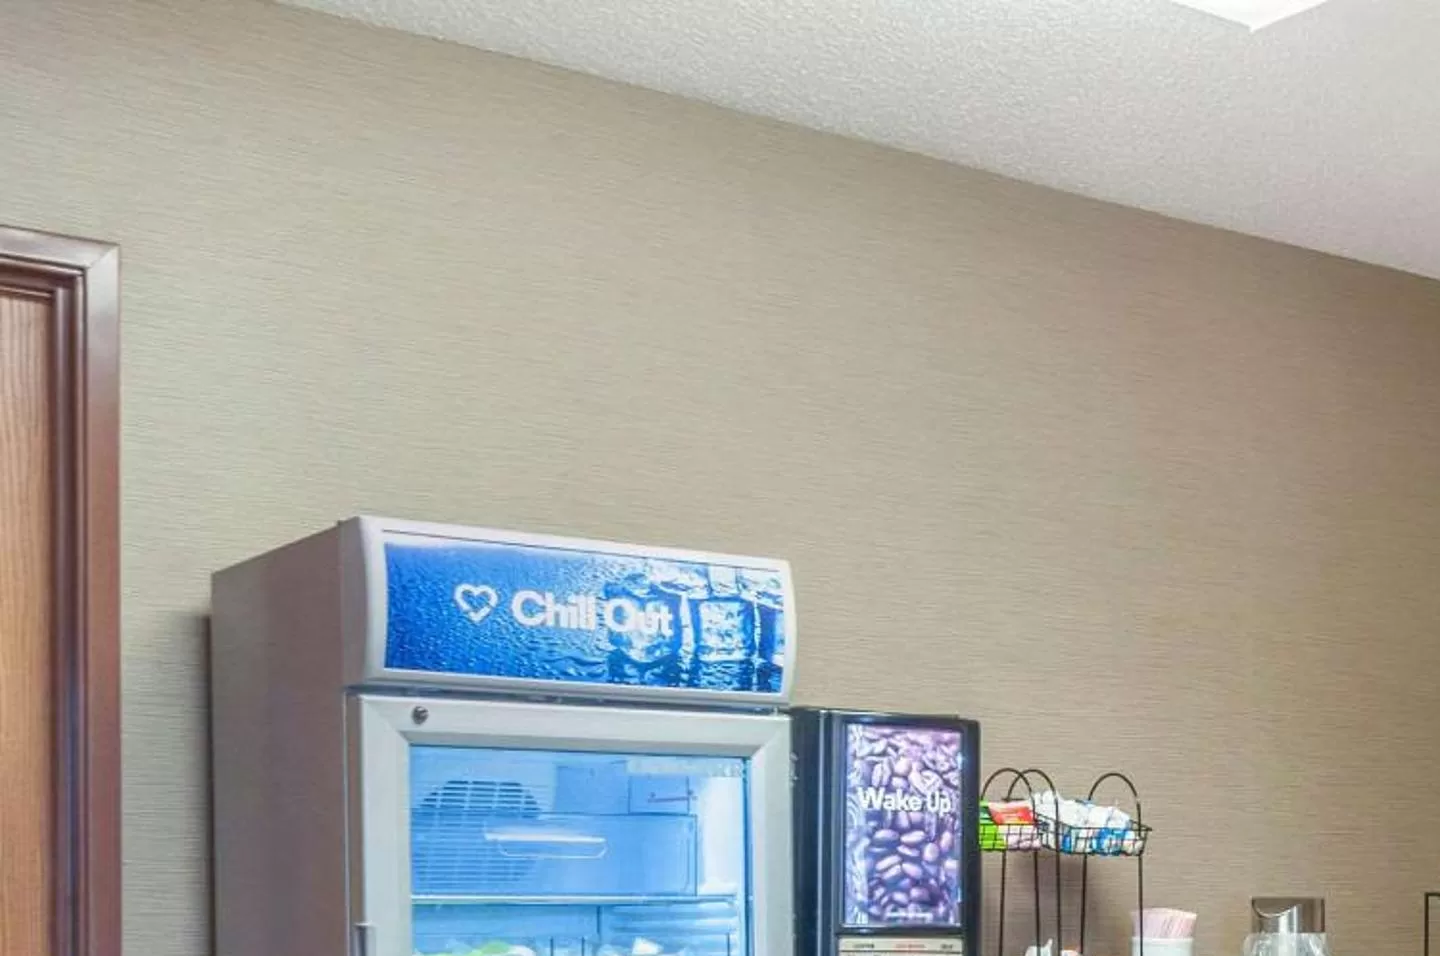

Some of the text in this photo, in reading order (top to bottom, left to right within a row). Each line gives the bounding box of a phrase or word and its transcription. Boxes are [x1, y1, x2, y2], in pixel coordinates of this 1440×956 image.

[511, 589, 675, 637] Chill Out
[857, 787, 951, 817] Wake Up
